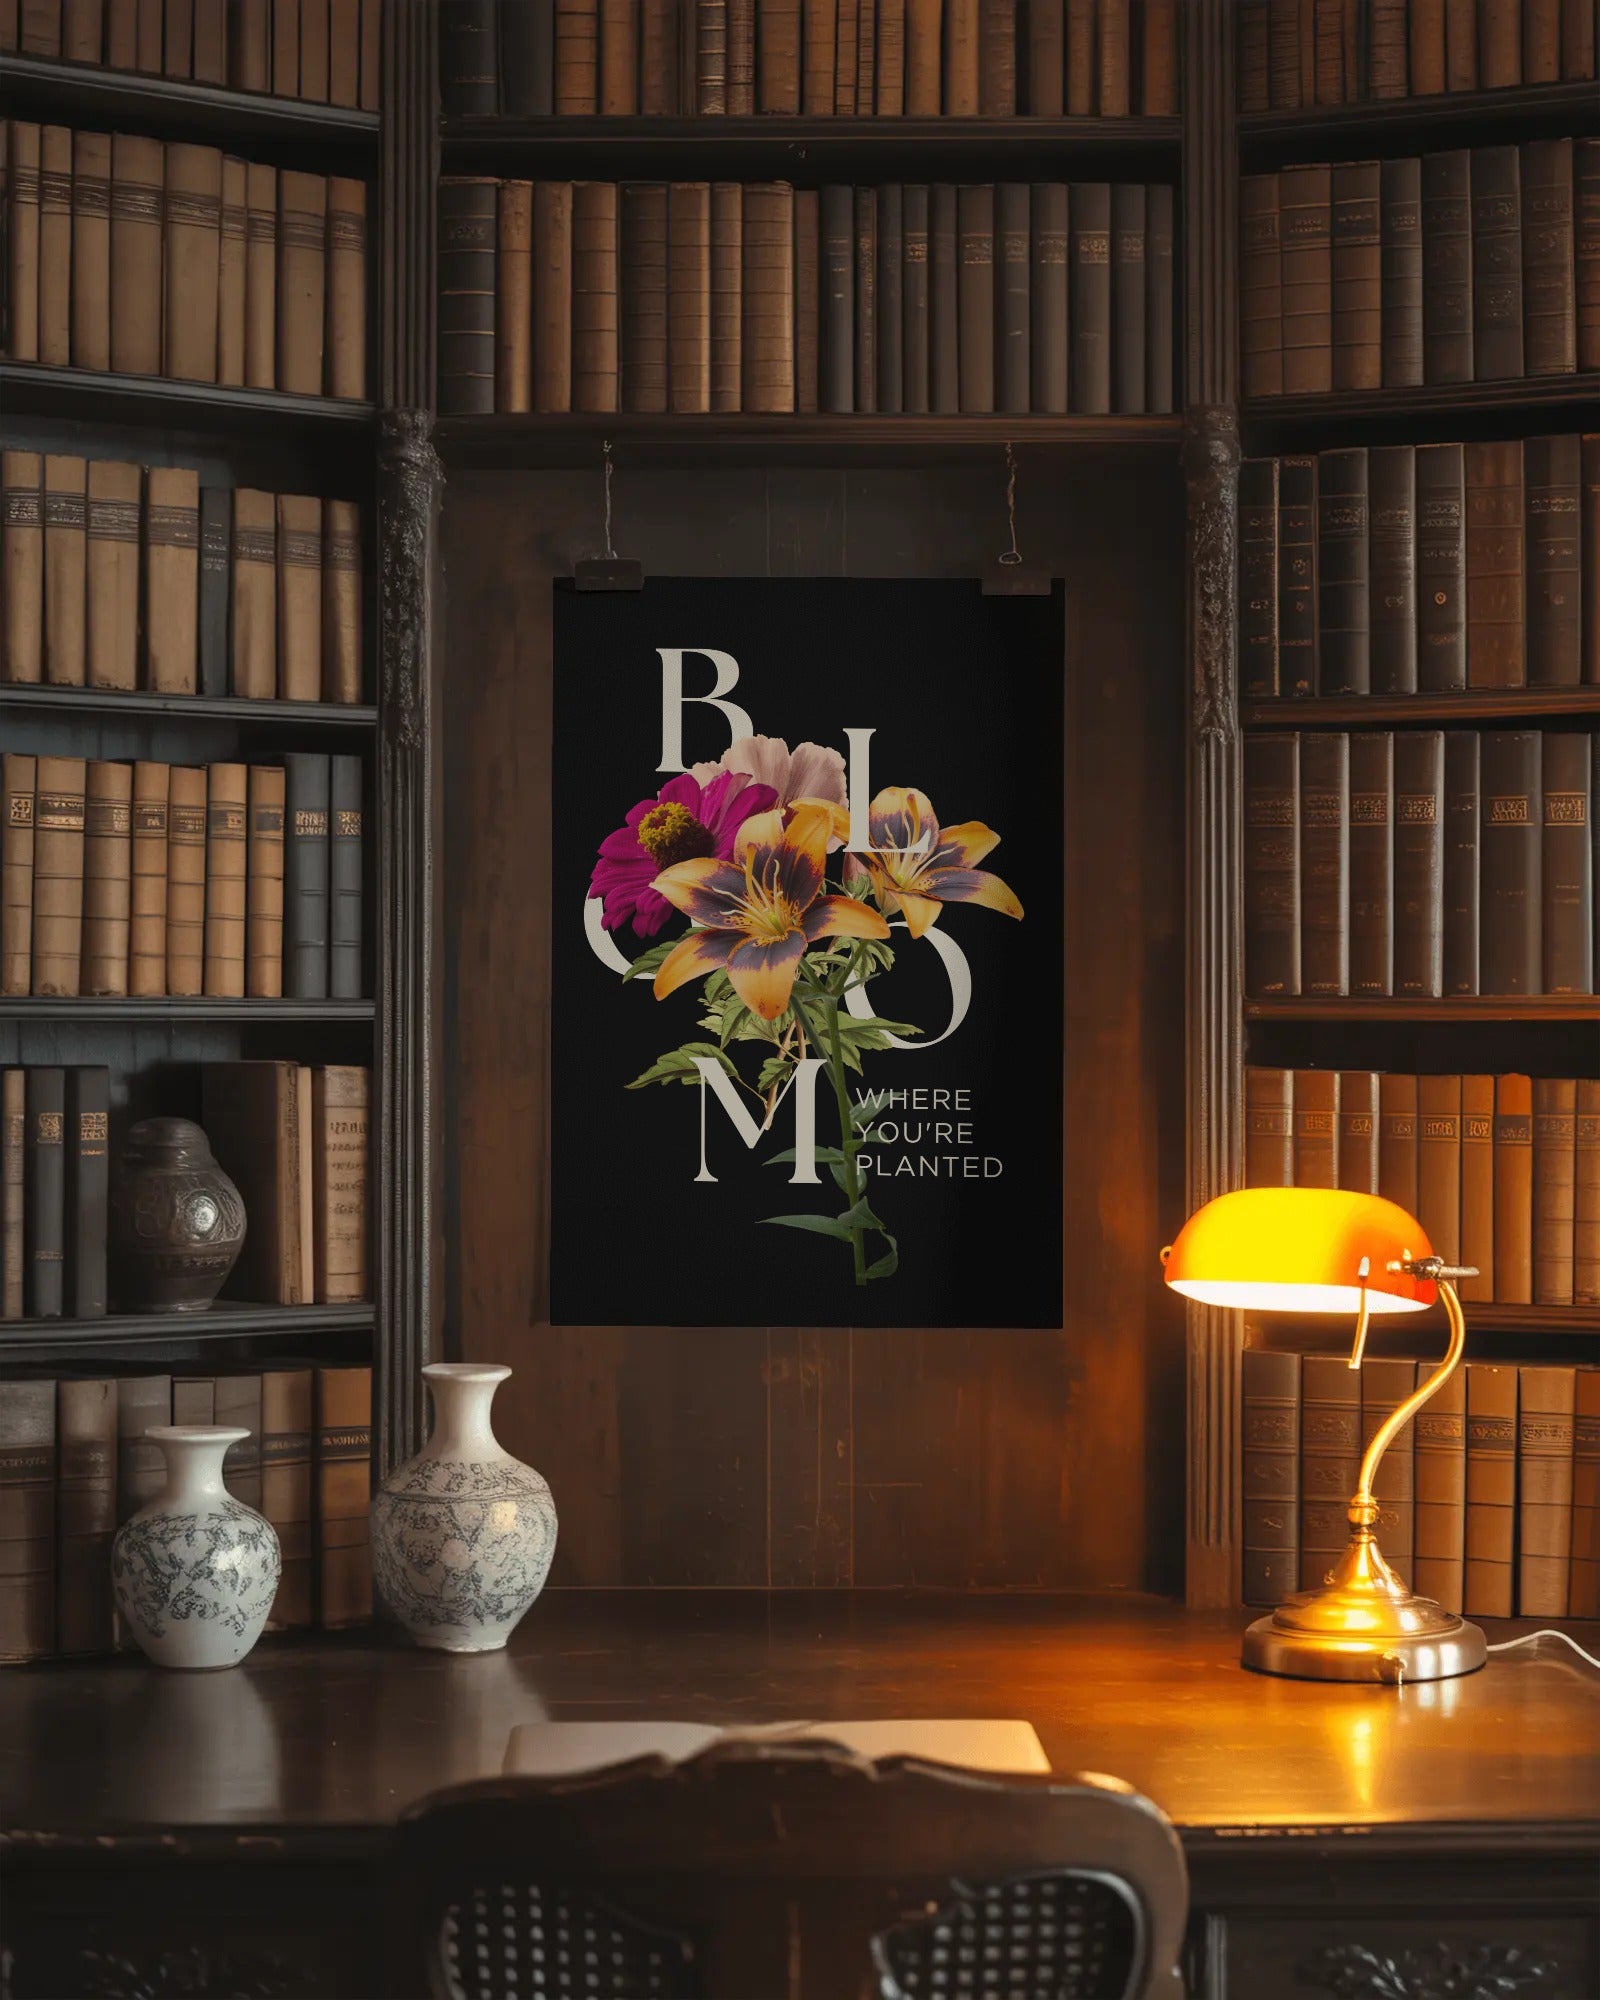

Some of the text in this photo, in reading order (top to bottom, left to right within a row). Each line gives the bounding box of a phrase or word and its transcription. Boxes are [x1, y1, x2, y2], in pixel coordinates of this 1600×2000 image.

[855, 1087, 971, 1111] WHERE
[855, 1120, 974, 1144] YOU'RE
[855, 1154, 1003, 1178] PLANTED
